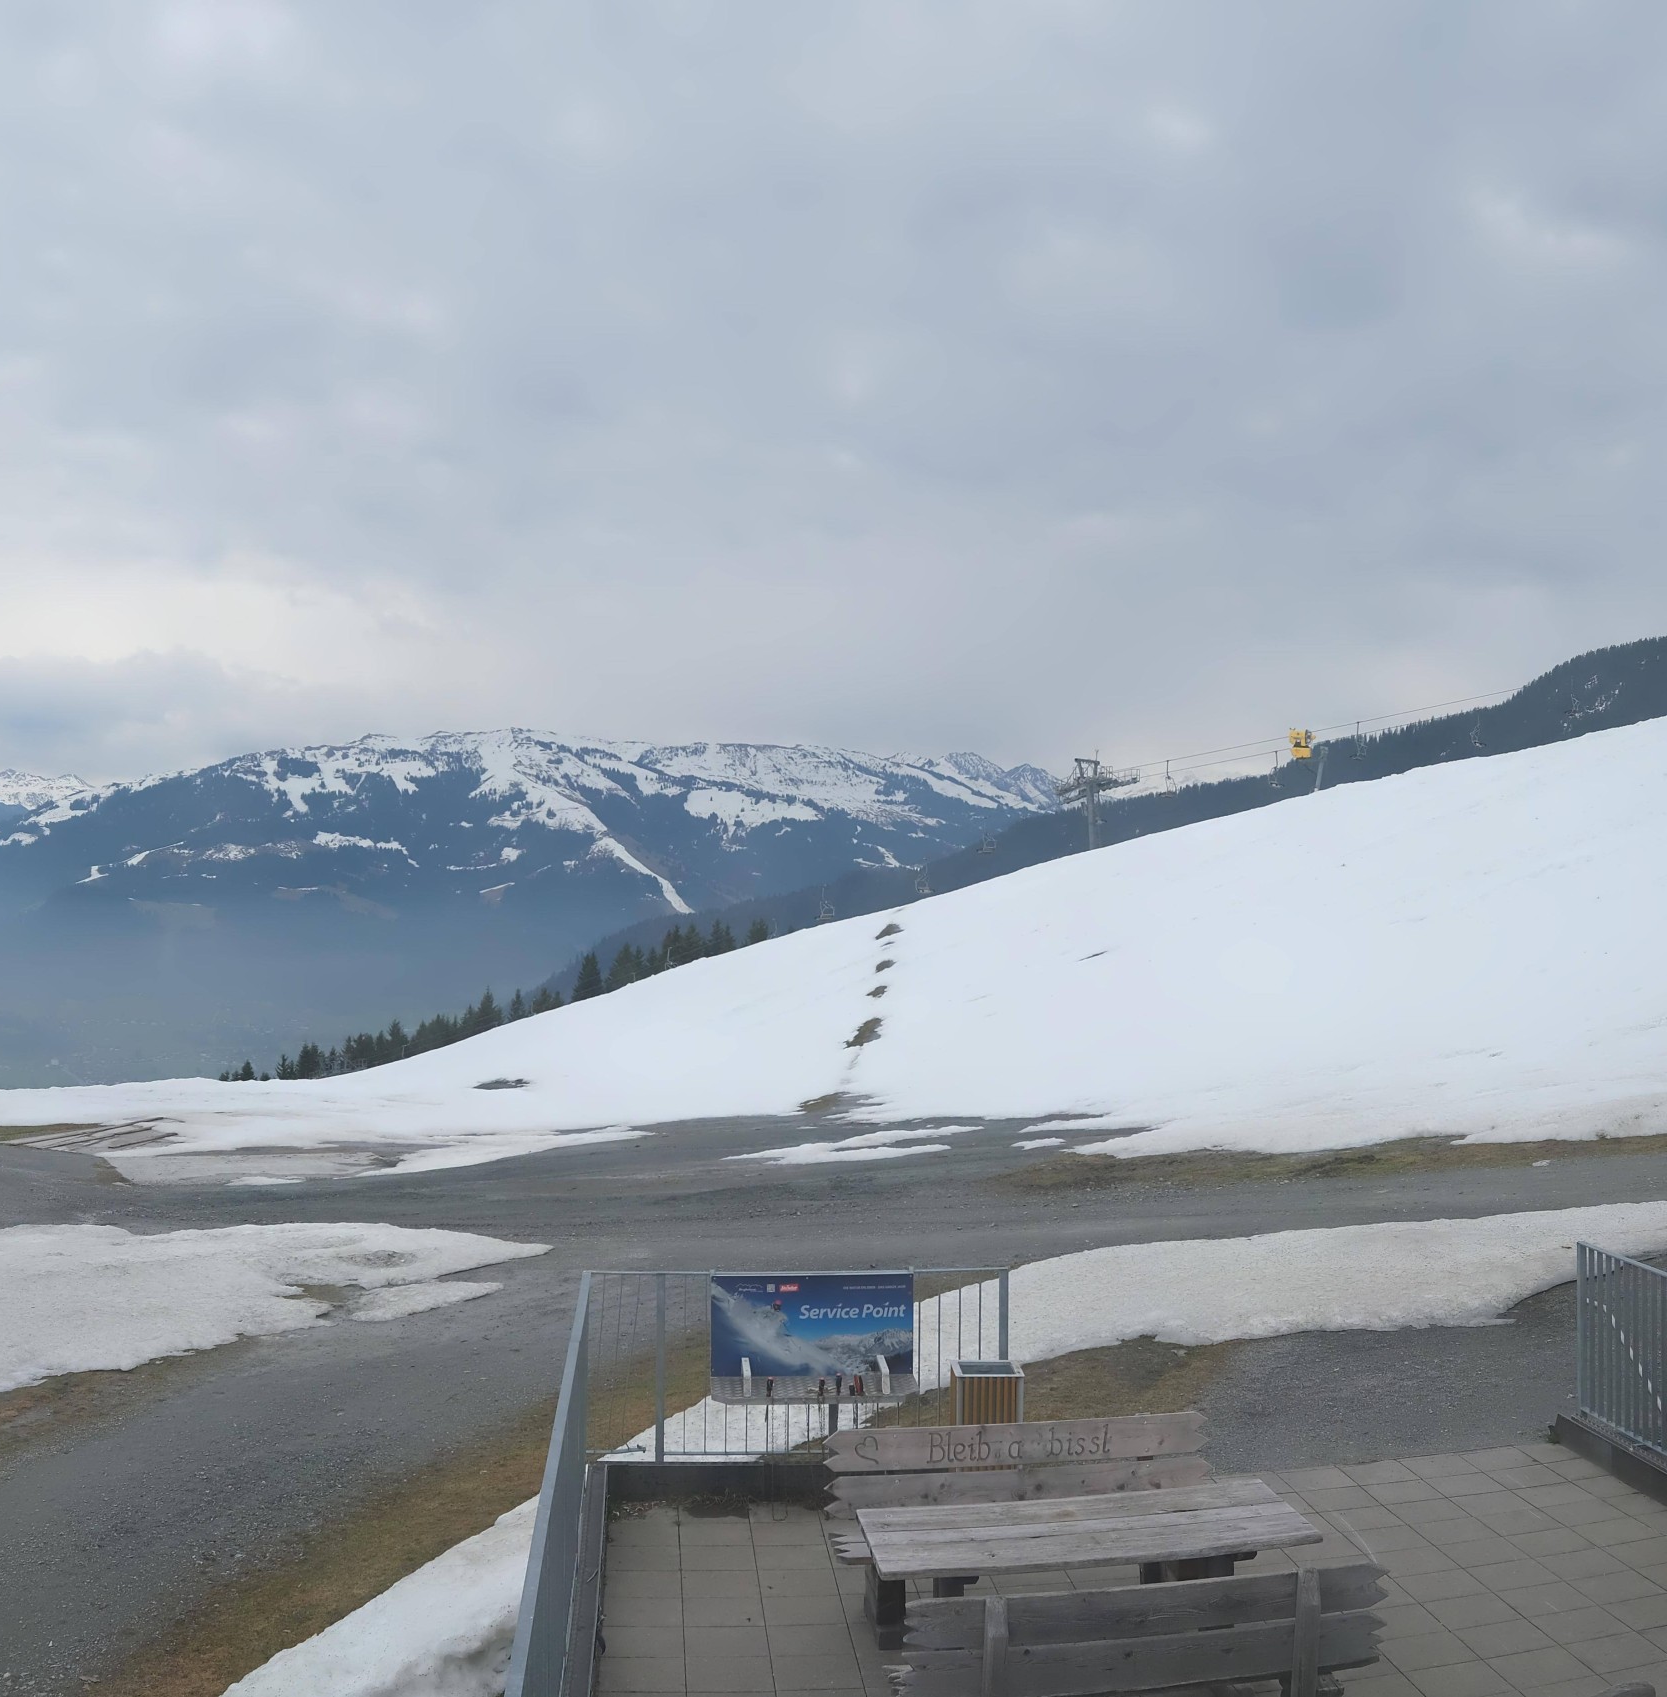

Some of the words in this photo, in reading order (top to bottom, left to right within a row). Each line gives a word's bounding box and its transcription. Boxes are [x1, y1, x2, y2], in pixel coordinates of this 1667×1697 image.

[799, 1303, 859, 1320] Service
[861, 1302, 906, 1319] Point
[926, 1430, 991, 1464] Bleib
[1008, 1440, 1023, 1460] a
[1047, 1423, 1110, 1458] bissl
